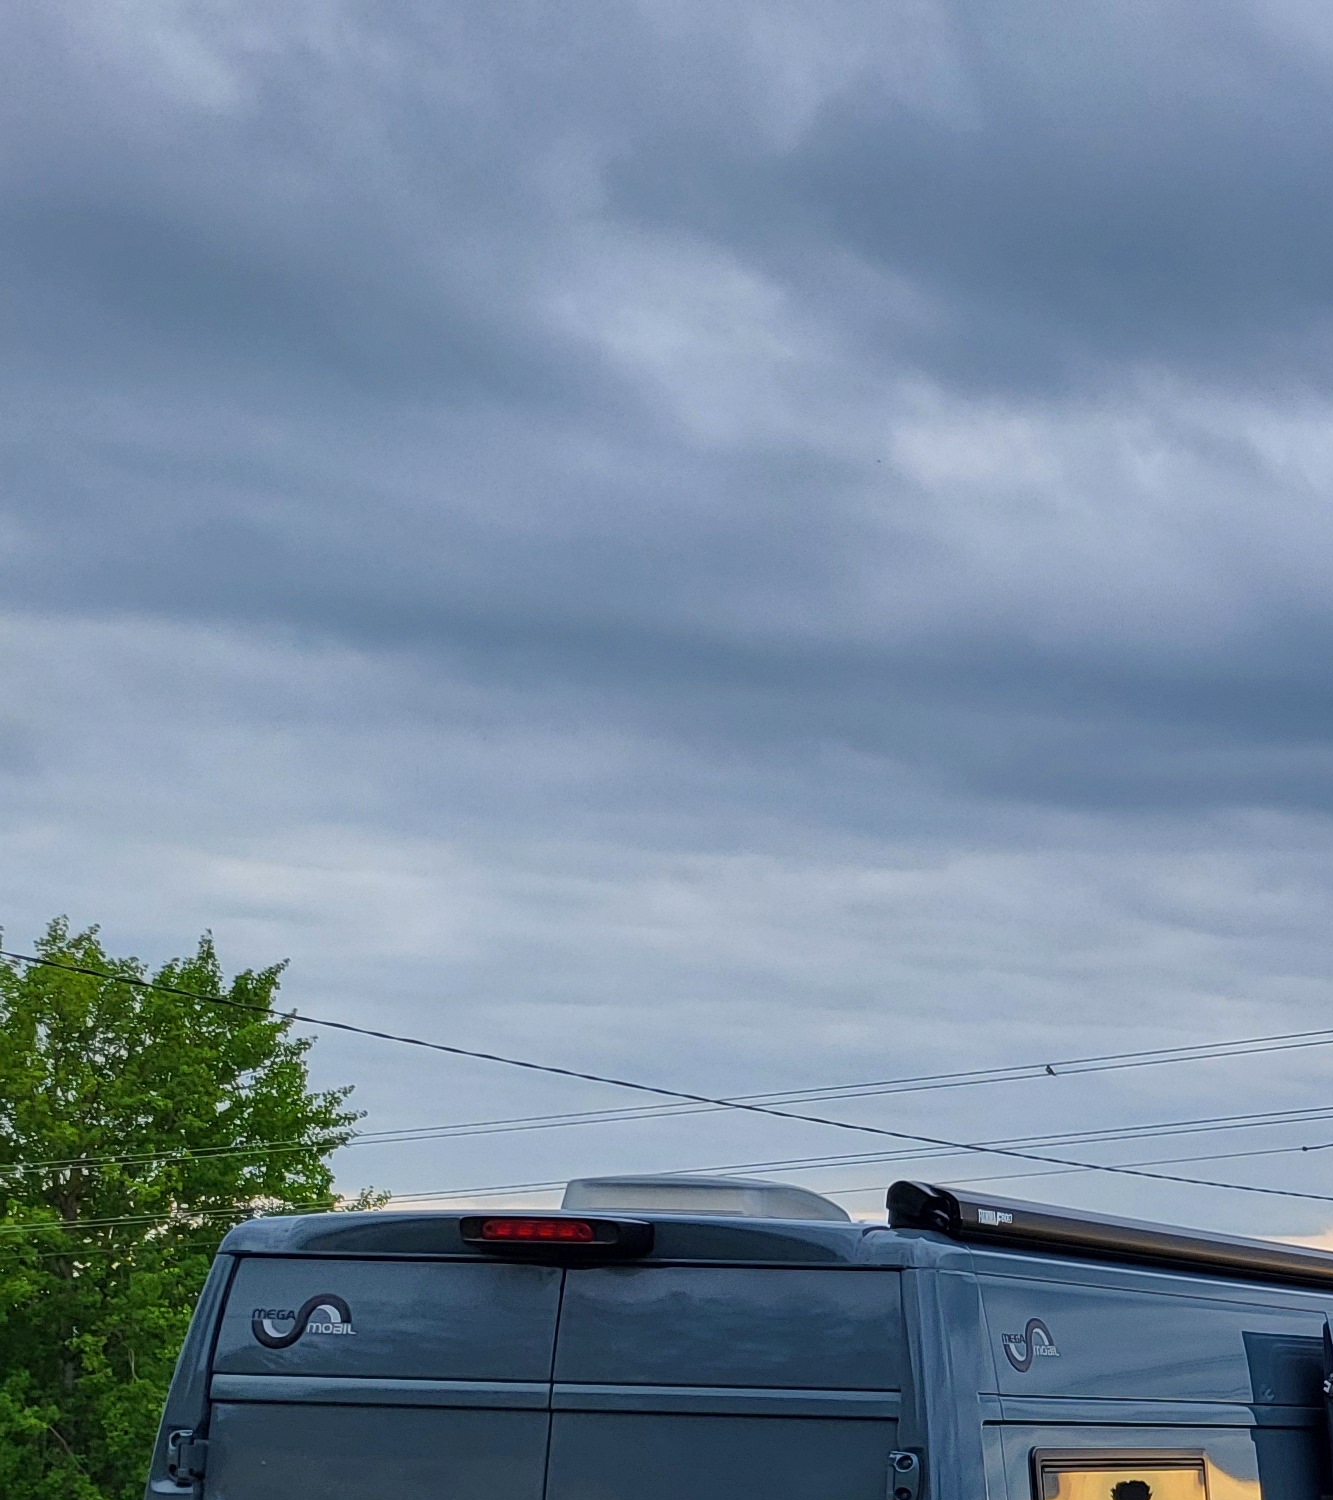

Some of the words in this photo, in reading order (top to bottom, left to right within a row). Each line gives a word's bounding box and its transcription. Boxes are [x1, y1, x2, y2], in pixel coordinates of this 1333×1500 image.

[252, 1309, 296, 1320] MEGA
[306, 1322, 357, 1335] MOBIL
[1001, 1333, 1026, 1343] MEGA
